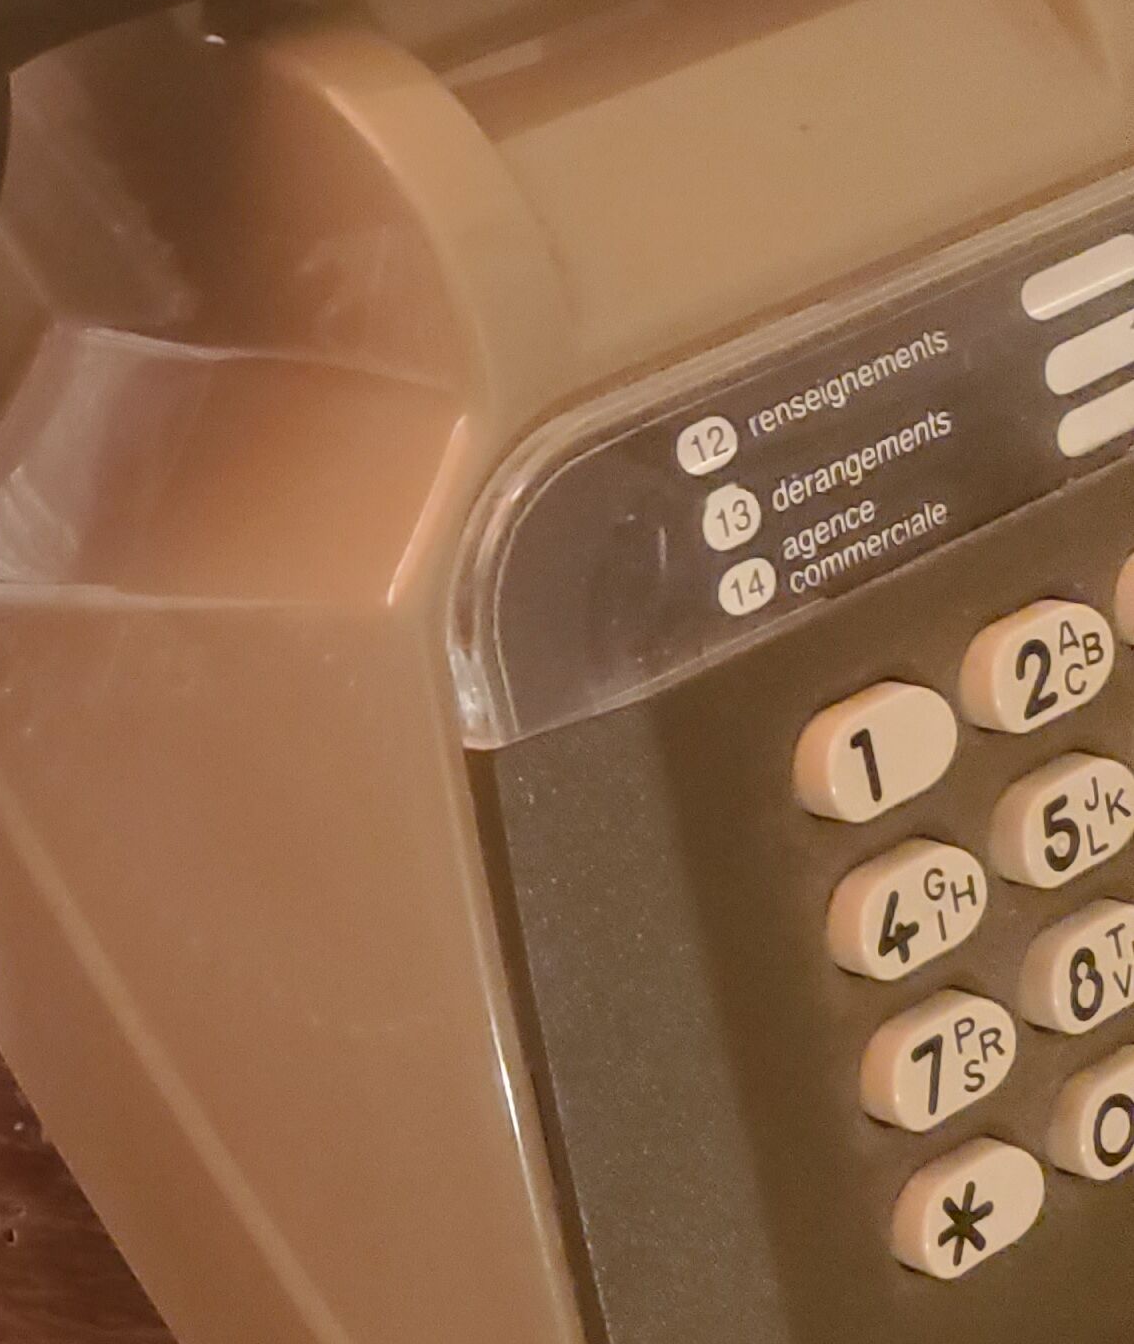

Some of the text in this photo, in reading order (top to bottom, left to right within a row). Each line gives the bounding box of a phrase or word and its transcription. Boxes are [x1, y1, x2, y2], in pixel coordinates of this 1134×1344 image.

[691, 330, 950, 463] 12 renseignements
[716, 410, 953, 538] 13 dérangements
[730, 499, 876, 607] 14 agence
[790, 502, 948, 594] commerciale
[850, 728, 883, 803] 1
